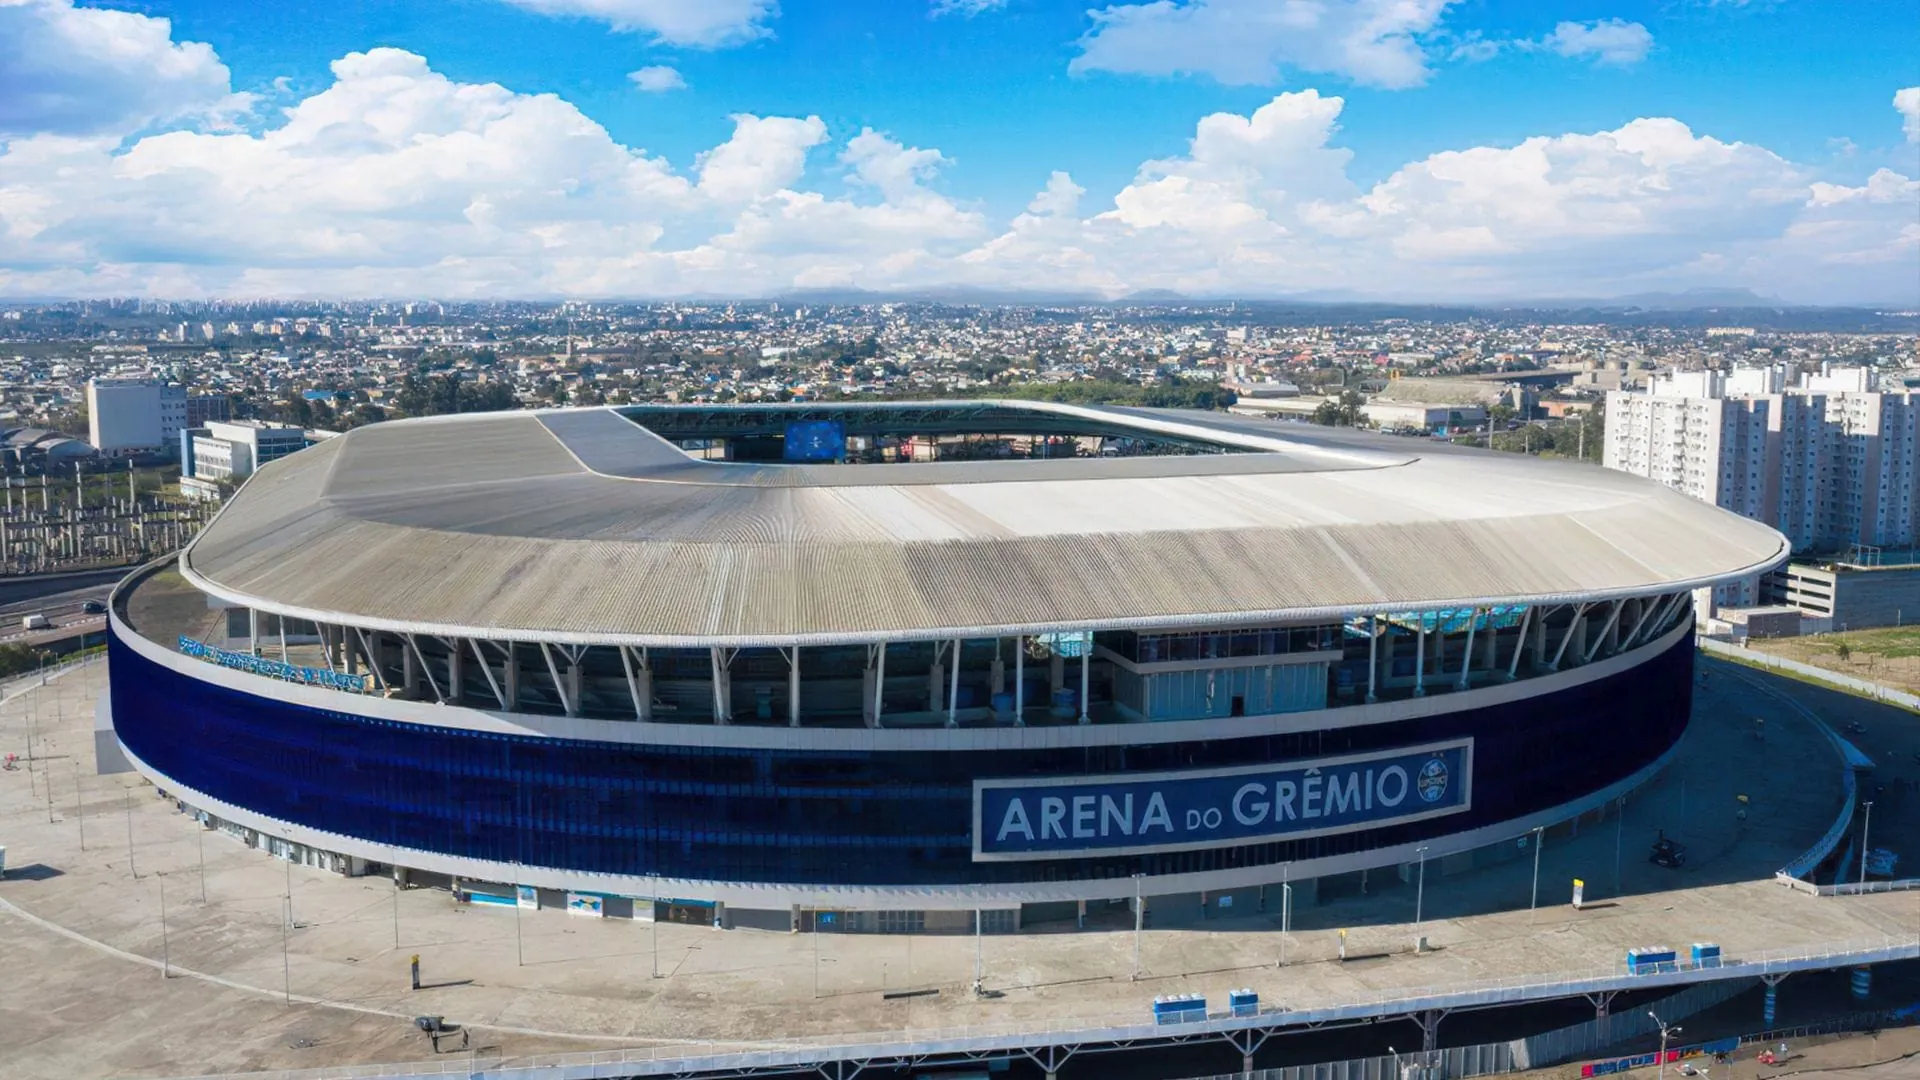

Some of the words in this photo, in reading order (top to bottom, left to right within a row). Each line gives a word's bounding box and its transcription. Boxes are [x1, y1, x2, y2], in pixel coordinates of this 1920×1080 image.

[996, 791, 1175, 841] ARENA
[1186, 807, 1222, 830] DO
[1232, 764, 1408, 826] GRÊMIO
